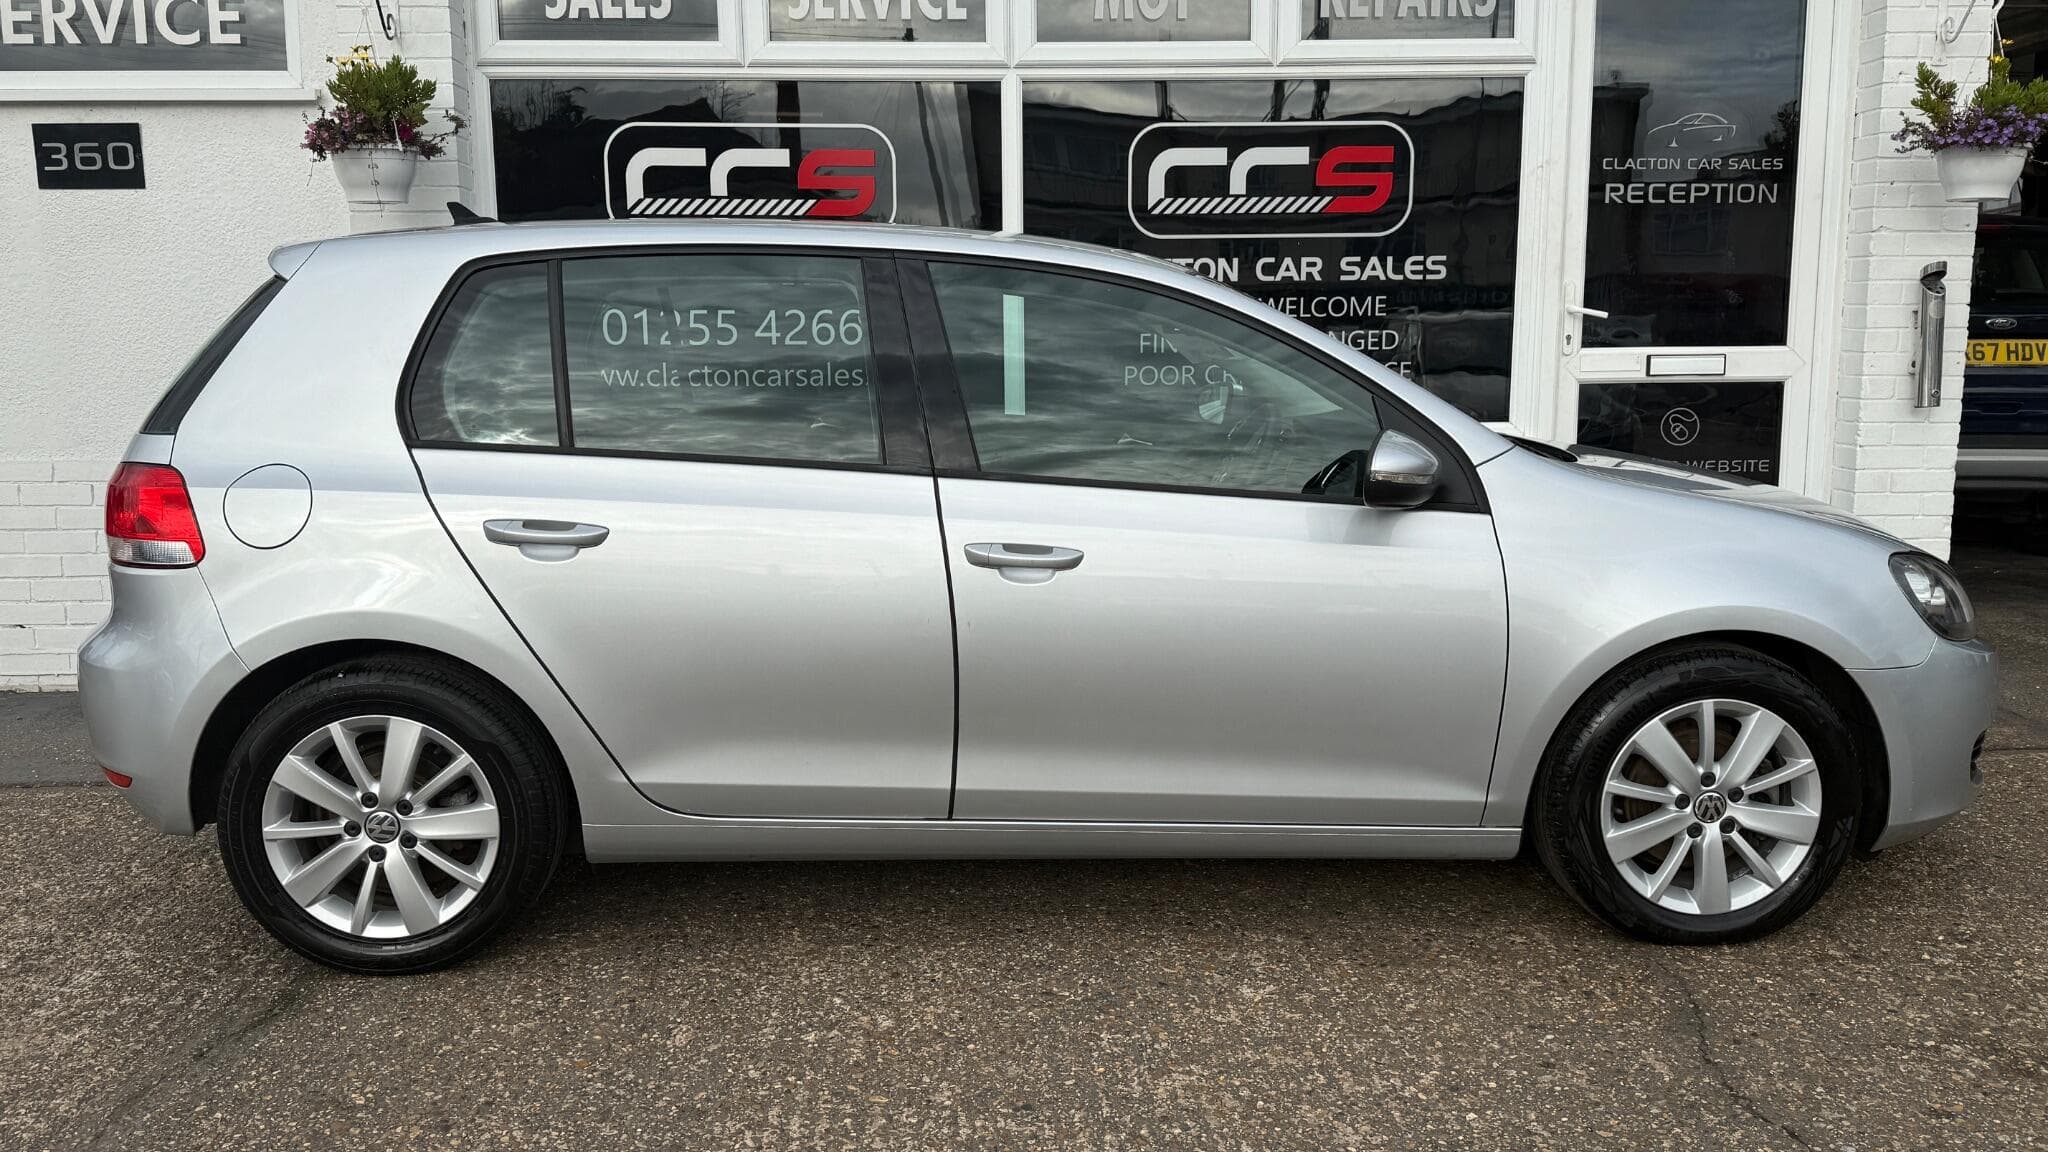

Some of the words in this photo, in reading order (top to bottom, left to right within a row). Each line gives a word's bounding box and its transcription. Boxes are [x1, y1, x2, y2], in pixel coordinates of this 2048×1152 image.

[41, 142, 135, 171] 360
[1602, 157, 1681, 170] CLACTON
[1687, 157, 1723, 170] CAR
[1728, 157, 1784, 170] SALES
[1604, 182, 1778, 204] RECEPTION
[1255, 256, 1323, 282] CAR
[1339, 255, 1448, 281] SALES
[1124, 364, 1197, 386] POOR
